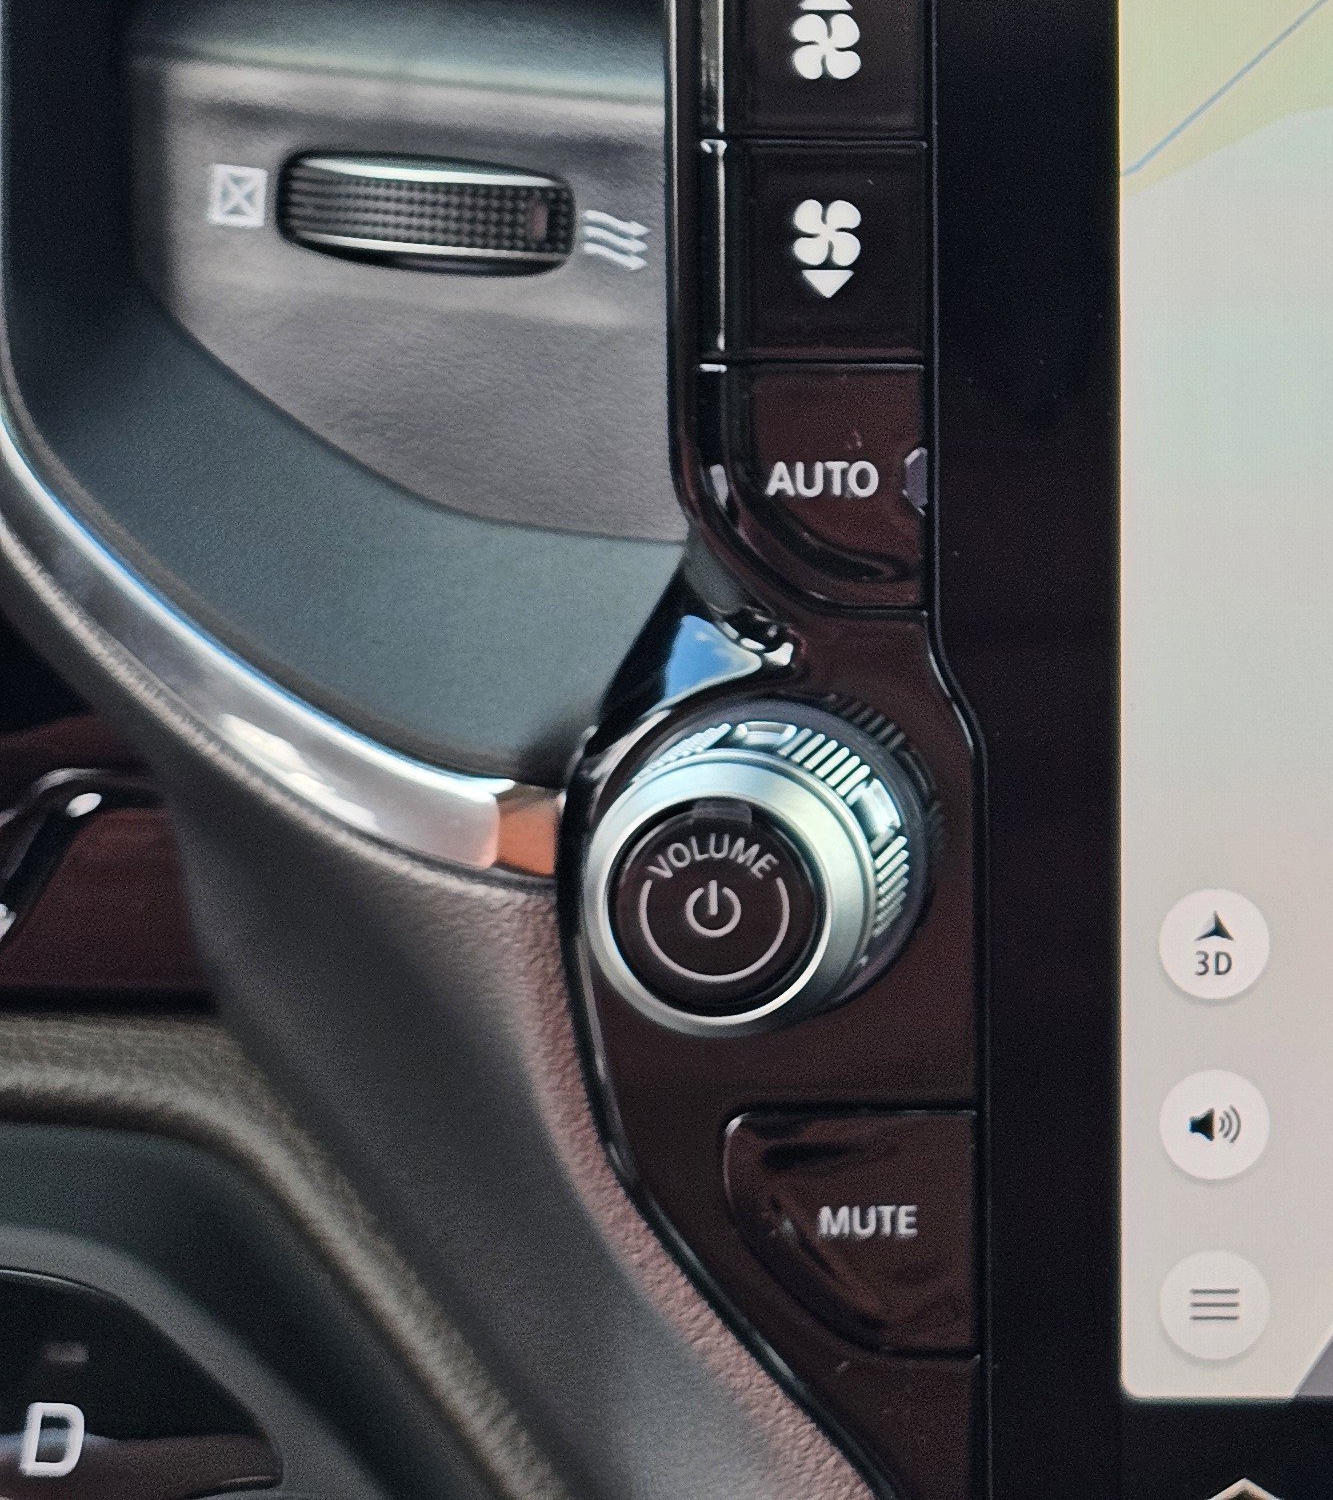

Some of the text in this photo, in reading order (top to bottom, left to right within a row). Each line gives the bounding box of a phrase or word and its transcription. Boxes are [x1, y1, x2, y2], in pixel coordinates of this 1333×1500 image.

[767, 460, 880, 498] AUTO
[646, 834, 780, 881] VOLUME
[1194, 950, 1233, 976] 3D
[818, 1205, 919, 1237] MUTE
[20, 1402, 85, 1478] D
